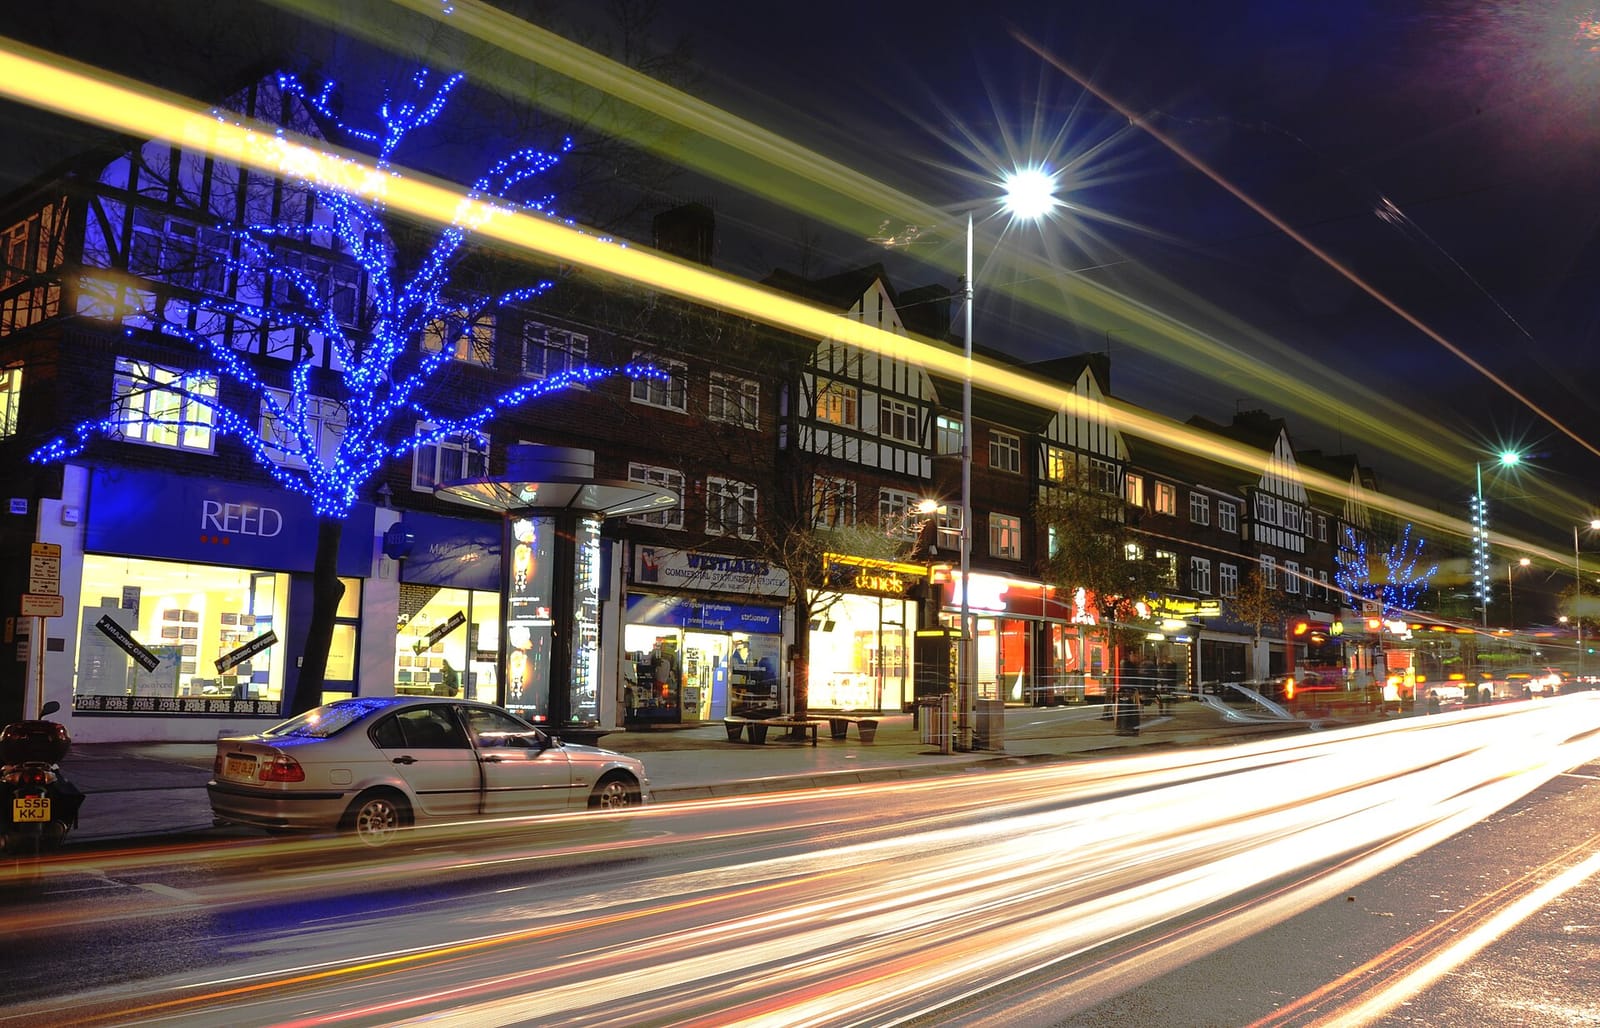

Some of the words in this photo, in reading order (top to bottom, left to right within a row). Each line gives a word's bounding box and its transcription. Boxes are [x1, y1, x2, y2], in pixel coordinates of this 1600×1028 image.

[201, 500, 283, 537] REED
[686, 553, 769, 576] WESTLAKES
[855, 568, 903, 593] daniels
[741, 613, 770, 625] stationery
[103, 622, 134, 650] AMAZING
[132, 646, 158, 670] OFFERS
[77, 699, 101, 707] JOBS
[106, 700, 128, 708] JOBS
[132, 700, 154, 708] JOBS
[159, 701, 181, 709] JOBS
[15, 799, 49, 809] LS56
[19, 809, 45, 819] KKJ
